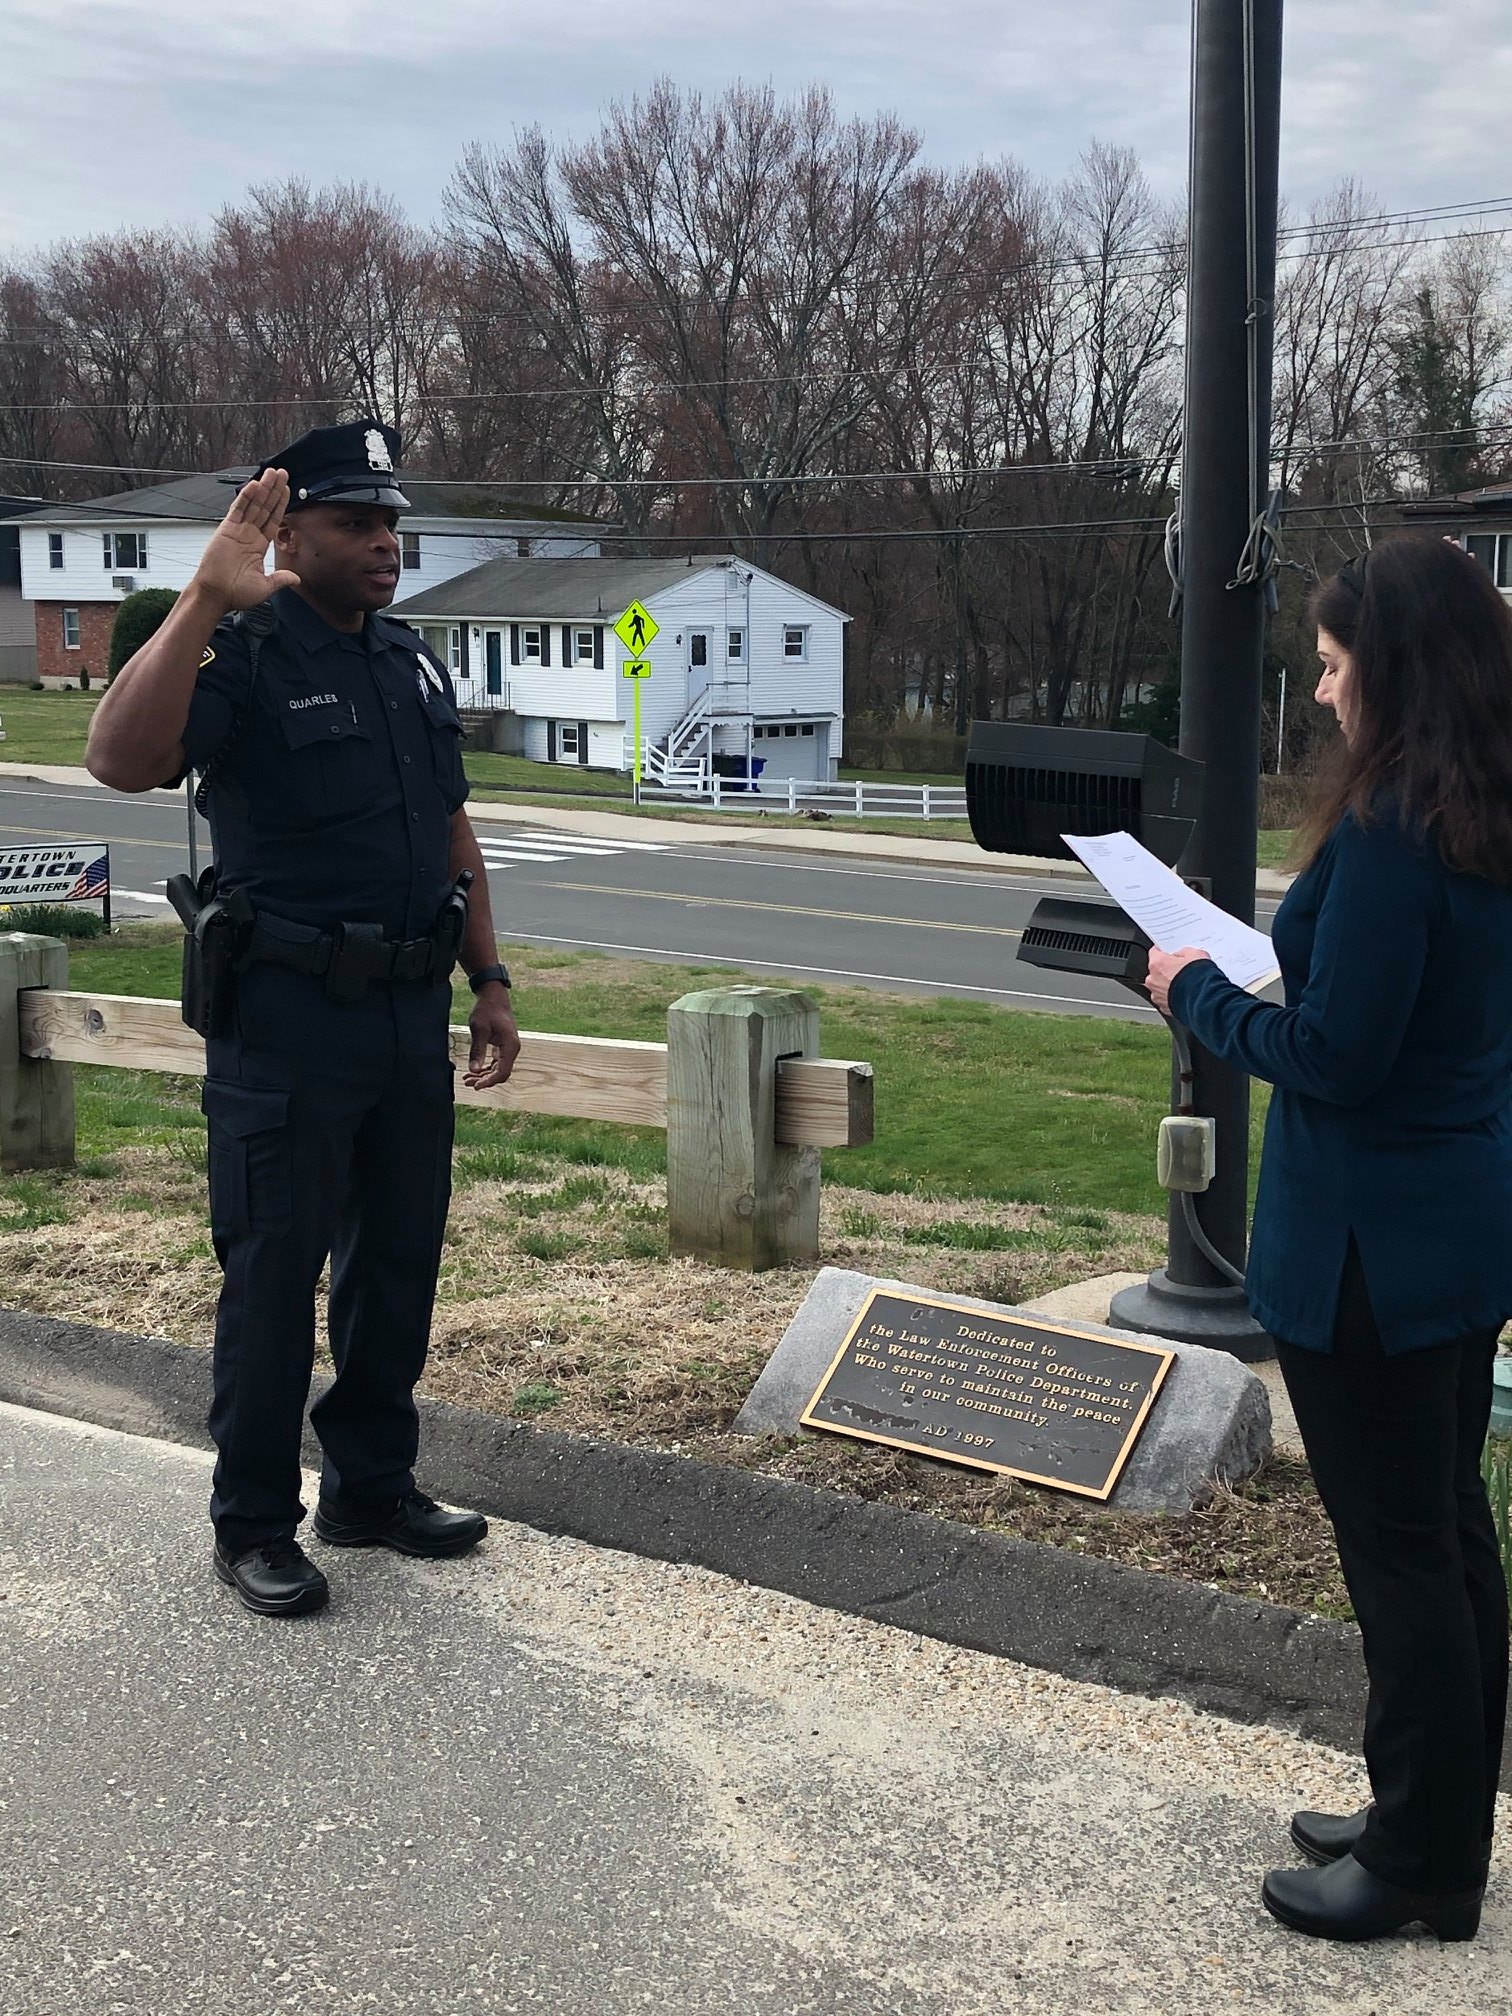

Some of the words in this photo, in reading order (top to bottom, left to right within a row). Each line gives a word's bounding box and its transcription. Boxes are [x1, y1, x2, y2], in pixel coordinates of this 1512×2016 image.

[289, 694, 338, 709] QUARLES
[869, 1323, 894, 1338] the
[898, 1329, 931, 1346] Law
[936, 1338, 1040, 1371] Enforcement
[1045, 1363, 1112, 1388] Officers
[1119, 1381, 1139, 1393] of
[956, 1325, 1035, 1352] Dedicated
[1041, 1344, 1057, 1358] to
[854, 1353, 887, 1371] Who
[891, 1364, 934, 1381] serve
[939, 1373, 955, 1386] to
[960, 1380, 1034, 1405] maintain
[1041, 1397, 1068, 1413] the
[1071, 1407, 1121, 1425] peace
[856, 1337, 880, 1352] the
[887, 1343, 969, 1372] Watertown
[974, 1363, 1024, 1385] Police
[1029, 1376, 1133, 1411] Department.
[899, 1381, 916, 1395] in
[922, 1388, 951, 1402] our
[956, 1397, 1049, 1427] community.
[922, 1423, 948, 1437] AD
[954, 1431, 995, 1449] 1997
